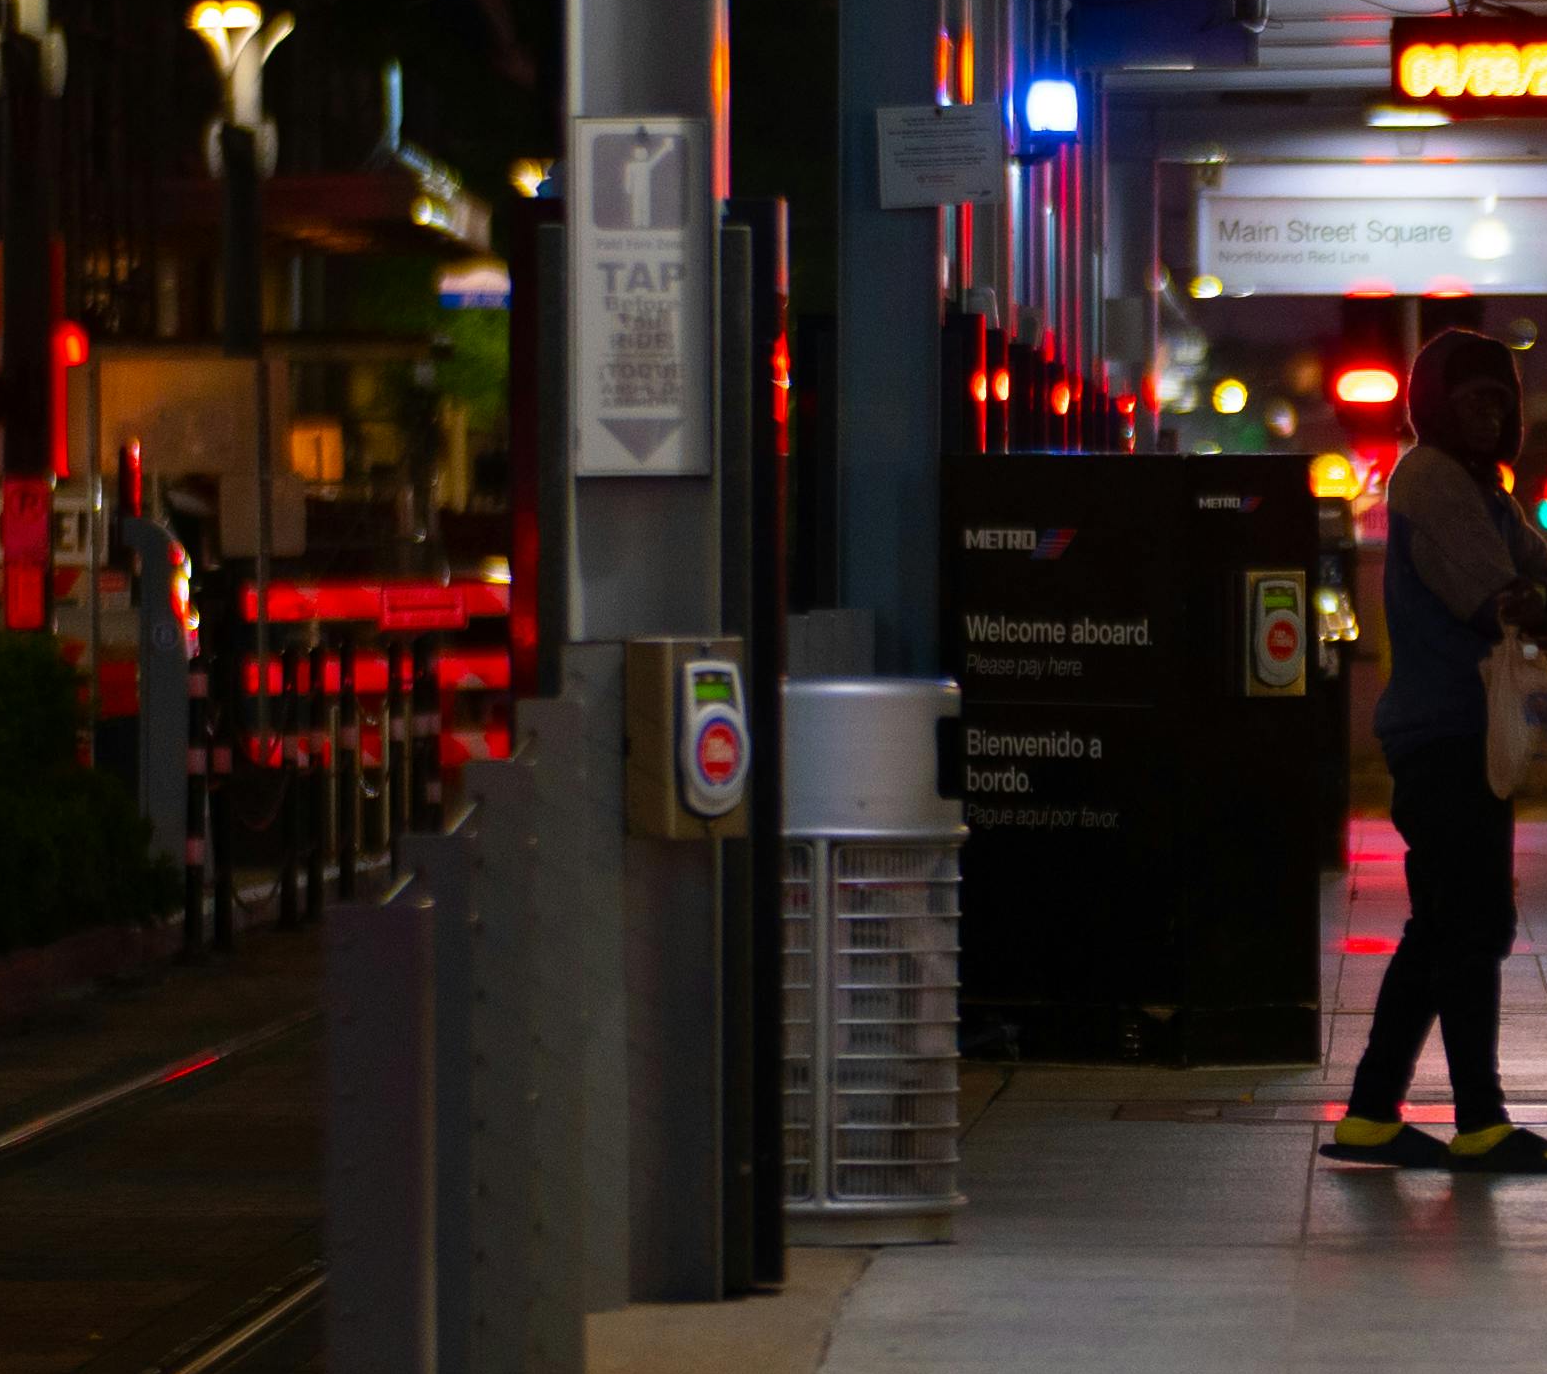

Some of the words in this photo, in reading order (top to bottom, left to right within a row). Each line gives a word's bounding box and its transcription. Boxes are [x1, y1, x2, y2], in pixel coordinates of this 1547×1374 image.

[1219, 220, 1279, 243] Main
[1287, 220, 1358, 243] Street
[1366, 220, 1453, 247] Square
[1219, 250, 1304, 264] Northbound
[1308, 250, 1336, 264] Red
[1340, 250, 1370, 264] Line
[597, 261, 686, 293] TAP
[1199, 496, 1243, 510] METRO
[965, 528, 1037, 551] METRO
[966, 614, 1066, 645] Welcome
[1071, 617, 1154, 646] aboard.
[965, 653, 1015, 676] Please
[1017, 658, 1046, 680] pay
[966, 728, 1085, 758] Bienvenido
[1089, 737, 1103, 759] a
[966, 765, 1034, 793] bordo.
[966, 803, 1014, 829] Pague
[1051, 809, 1078, 831] por
